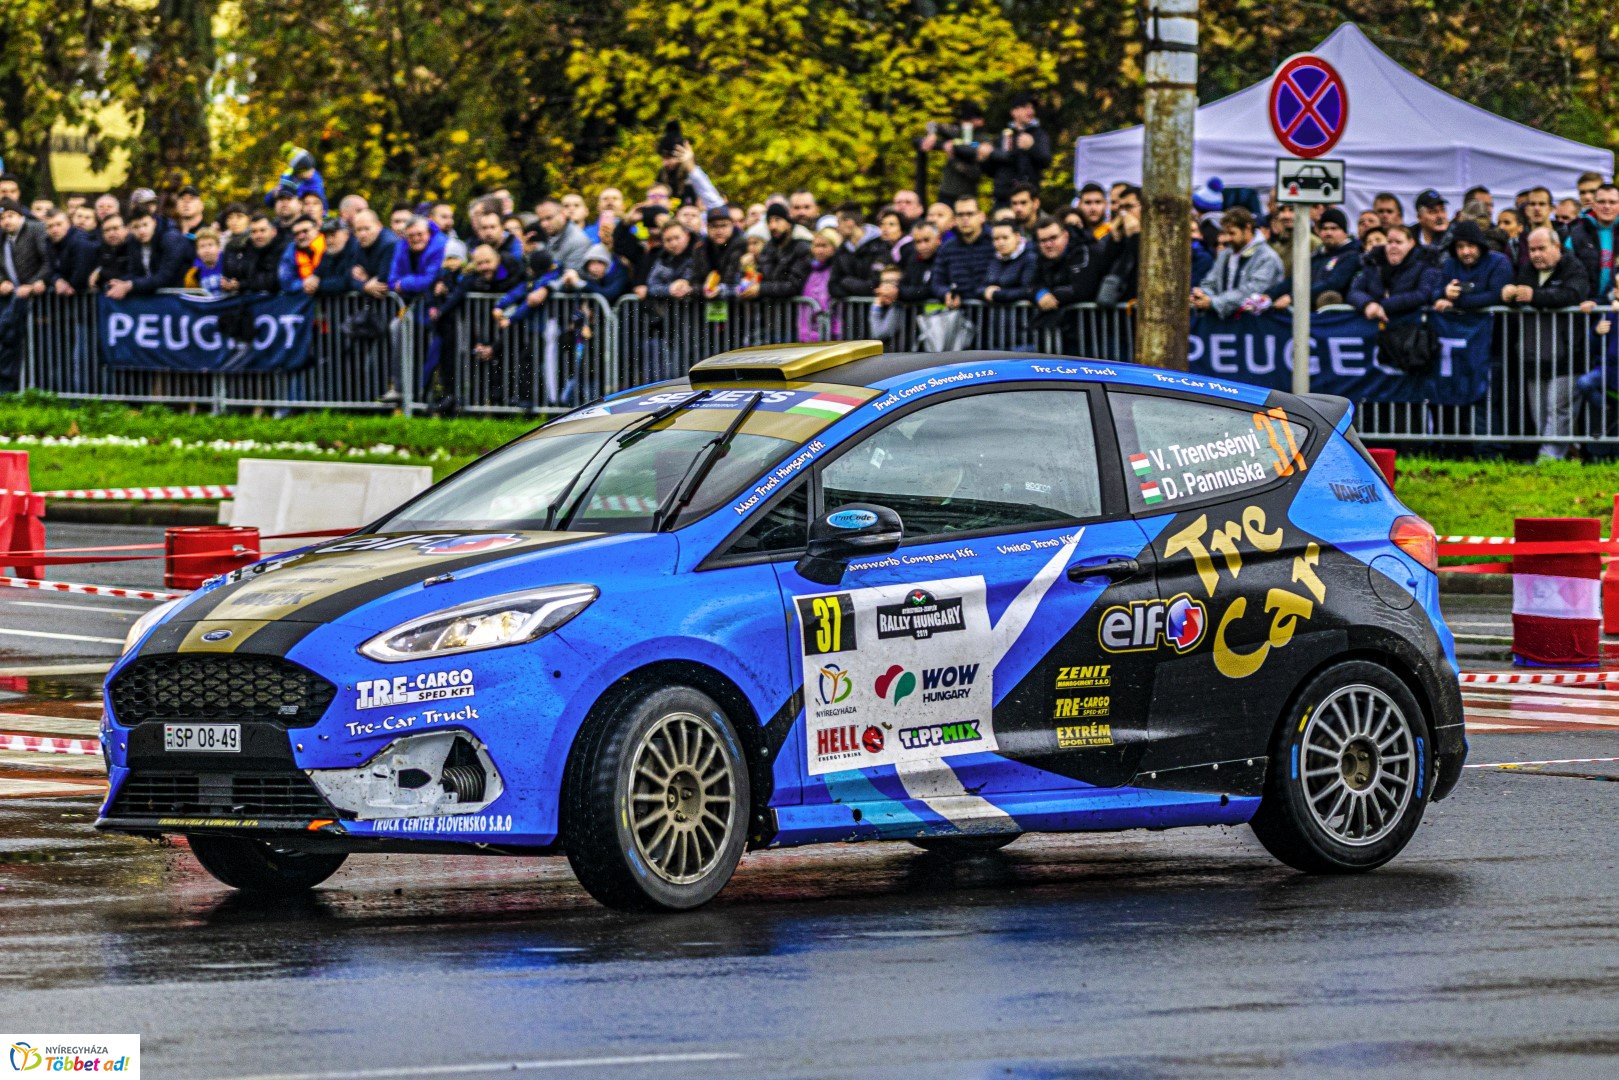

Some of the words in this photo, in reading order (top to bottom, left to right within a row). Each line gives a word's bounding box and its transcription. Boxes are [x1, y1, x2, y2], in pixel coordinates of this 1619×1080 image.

[98, 312, 305, 351] PEUGOT
[1031, 364, 1078, 375] Tre-Car
[1080, 366, 1118, 377] Truck
[872, 394, 900, 412] Truck
[898, 383, 928, 399] Center
[927, 371, 974, 388] Slovensko
[1152, 373, 1205, 389] Tre-Car
[1208, 382, 1239, 396] Plus
[1149, 449, 1172, 471] V.
[1168, 428, 1262, 467] Trencsényi
[1252, 406, 1308, 477] 37
[733, 494, 760, 516] Maxx
[754, 475, 780, 500] Truck
[775, 450, 814, 479] Hungary
[808, 439, 827, 456] Kft.
[1161, 476, 1185, 500] D.
[1182, 459, 1267, 496] Pannuska
[845, 556, 900, 572] answorld
[901, 550, 956, 566] Company
[957, 548, 979, 560] Kft.
[997, 542, 1032, 556] United
[1031, 537, 1060, 551] Trend
[1163, 505, 1283, 598] Tre
[879, 614, 911, 633] RALLY
[912, 605, 962, 629] HUNGARY
[1213, 541, 1327, 679] Car
[812, 596, 842, 653] 37
[916, 629, 929, 638] 2019
[1101, 604, 1165, 648] elf
[922, 663, 980, 690] WOW
[1056, 665, 1111, 680] ZENIT
[356, 668, 473, 709] TRE-CARGO
[419, 691, 447, 700] SPED
[451, 687, 472, 696] KFT
[922, 688, 971, 704] HUNGARY
[816, 706, 857, 718] NYÍREGYHÁZA
[1055, 696, 1109, 717] TRE-CARGO
[346, 716, 416, 736] Tre-Car
[422, 705, 479, 724] Truck
[1056, 722, 1111, 738] EXTRÉM
[176, 728, 193, 747] SP
[198, 728, 237, 748] 08-49
[816, 725, 861, 755] HELL
[818, 754, 841, 762] ENERGY
[373, 819, 399, 831] TRUCK
[403, 818, 434, 831] CENTER
[437, 816, 486, 832] SLOVENSKO
[489, 815, 512, 832] S.R.O
